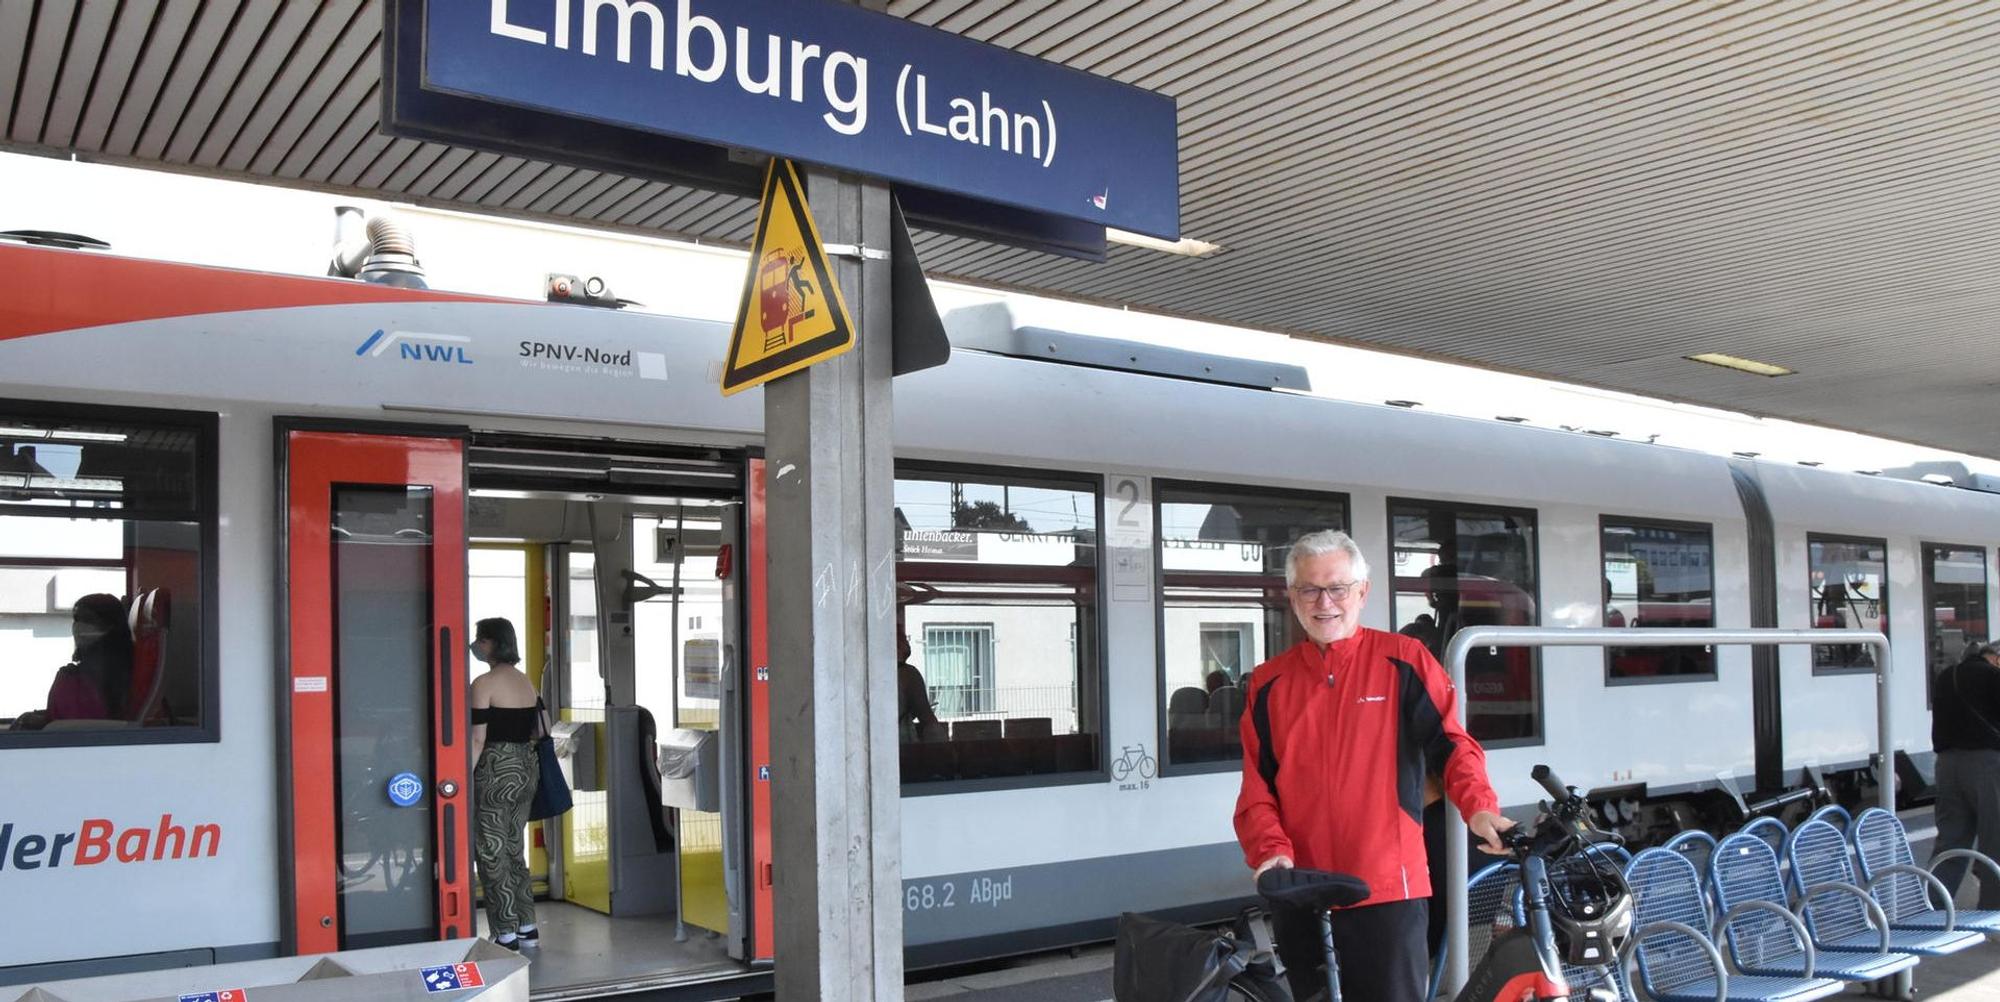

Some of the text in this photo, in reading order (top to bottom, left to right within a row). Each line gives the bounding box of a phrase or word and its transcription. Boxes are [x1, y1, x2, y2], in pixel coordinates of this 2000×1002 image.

[896, 63, 1057, 168] (Lahn)
[400, 342, 473, 364] NWL
[519, 341, 631, 366] SPNV-Nord
[1116, 479, 1140, 527] 2
[902, 874, 1012, 911] 68.2 ABpd
